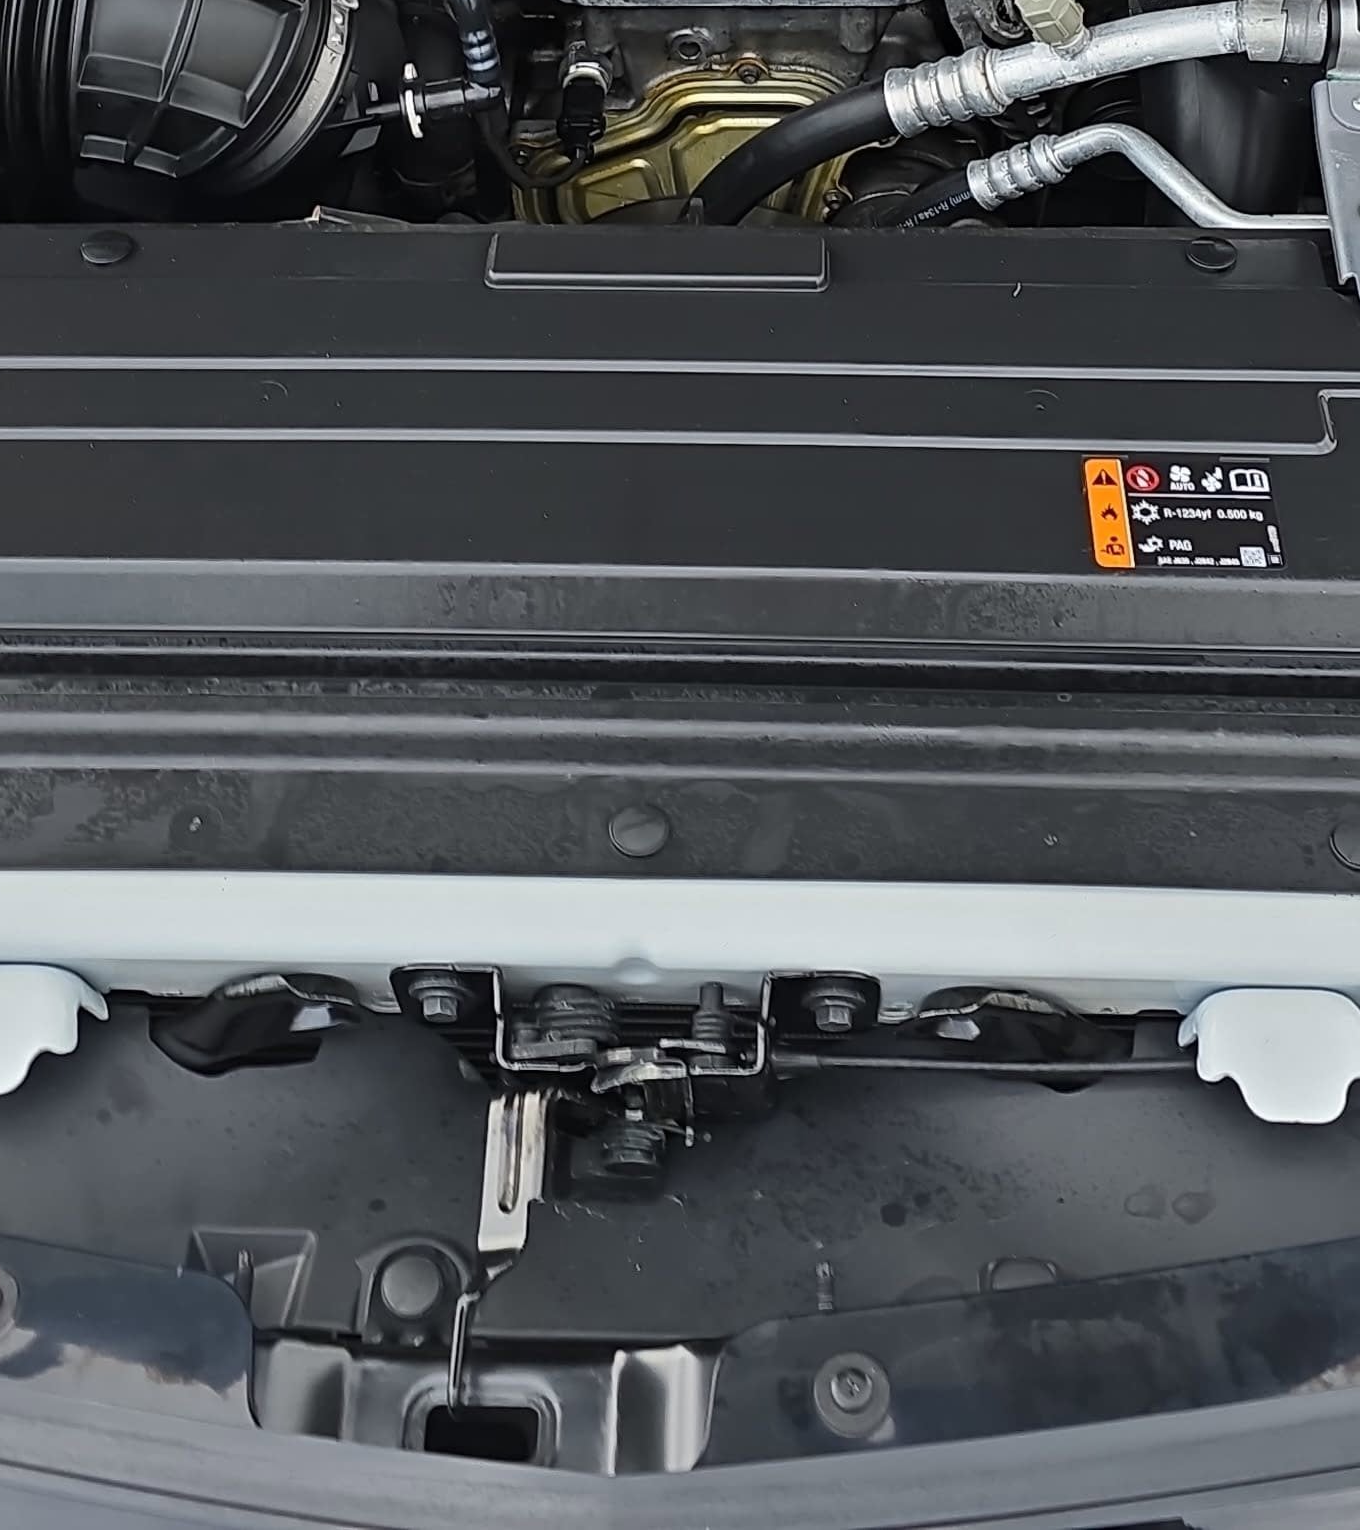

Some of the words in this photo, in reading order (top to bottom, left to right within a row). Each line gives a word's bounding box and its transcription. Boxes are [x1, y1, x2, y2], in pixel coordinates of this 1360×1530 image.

[1169, 481, 1196, 491] AUTO
[1162, 507, 1212, 521] R-1234yf
[1248, 509, 1264, 522] kg
[1168, 539, 1193, 551] PAG
